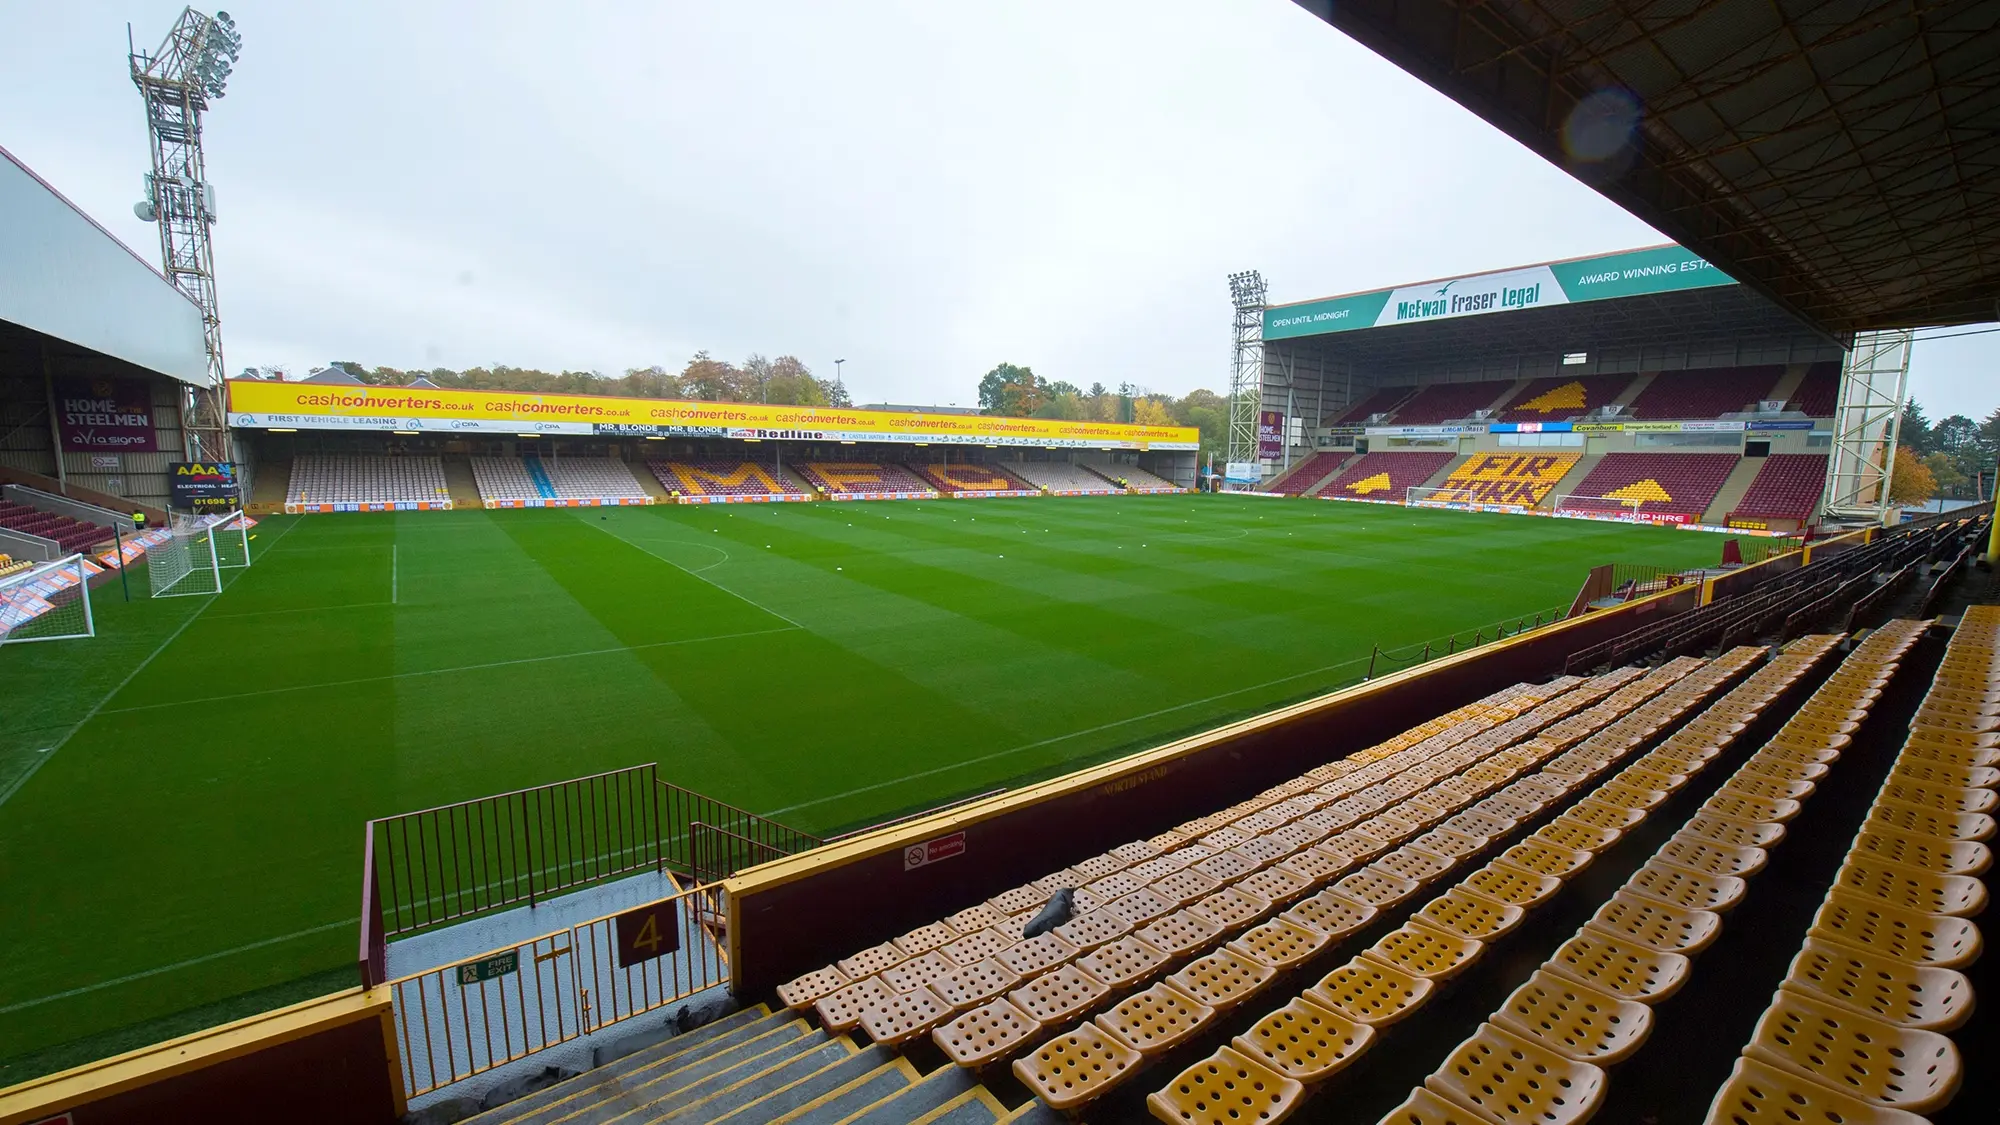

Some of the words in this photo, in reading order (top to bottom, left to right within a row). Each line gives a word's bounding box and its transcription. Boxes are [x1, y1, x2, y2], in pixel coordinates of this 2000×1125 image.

[1577, 271, 1620, 286] AWARD
[1623, 263, 1677, 280] WINNING
[1396, 299, 1447, 320] McEwan
[1451, 291, 1497, 313] Fraser
[1501, 283, 1540, 308] Legal
[1272, 316, 1291, 327] OPEN
[1292, 313, 1312, 325] UNTIL
[1314, 309, 1350, 322] MIDNIGHT
[65, 399, 117, 413] HOME
[297, 392, 474, 411] cashconverters.co.uk
[485, 400, 630, 417] cashconverters.co.uk
[66, 413, 148, 427] STEELMEN
[268, 415, 300, 423] FIRST
[303, 416, 350, 424] VEHICLE
[352, 417, 397, 425] LEASING
[650, 408, 769, 422] cashconverters.co.uk
[775, 413, 875, 426] cashconverters.co.uk
[599, 423, 617, 431] MR.
[619, 424, 658, 432] BLONDE
[669, 425, 685, 433] MR.
[889, 418, 972, 429] cashconverters.co.uk
[1260, 425, 1274, 434] HOME
[757, 429, 823, 440] Redline
[1259, 434, 1280, 442] STEELMEN
[1470, 456, 1559, 477] FIR
[1620, 512, 1650, 520] SKIP
[1652, 514, 1684, 522] HIRE
[1670, 577, 1680, 588] 3
[633, 913, 664, 952] 4
[488, 955, 513, 969] FIRE
[488, 963, 513, 977] EXIT
